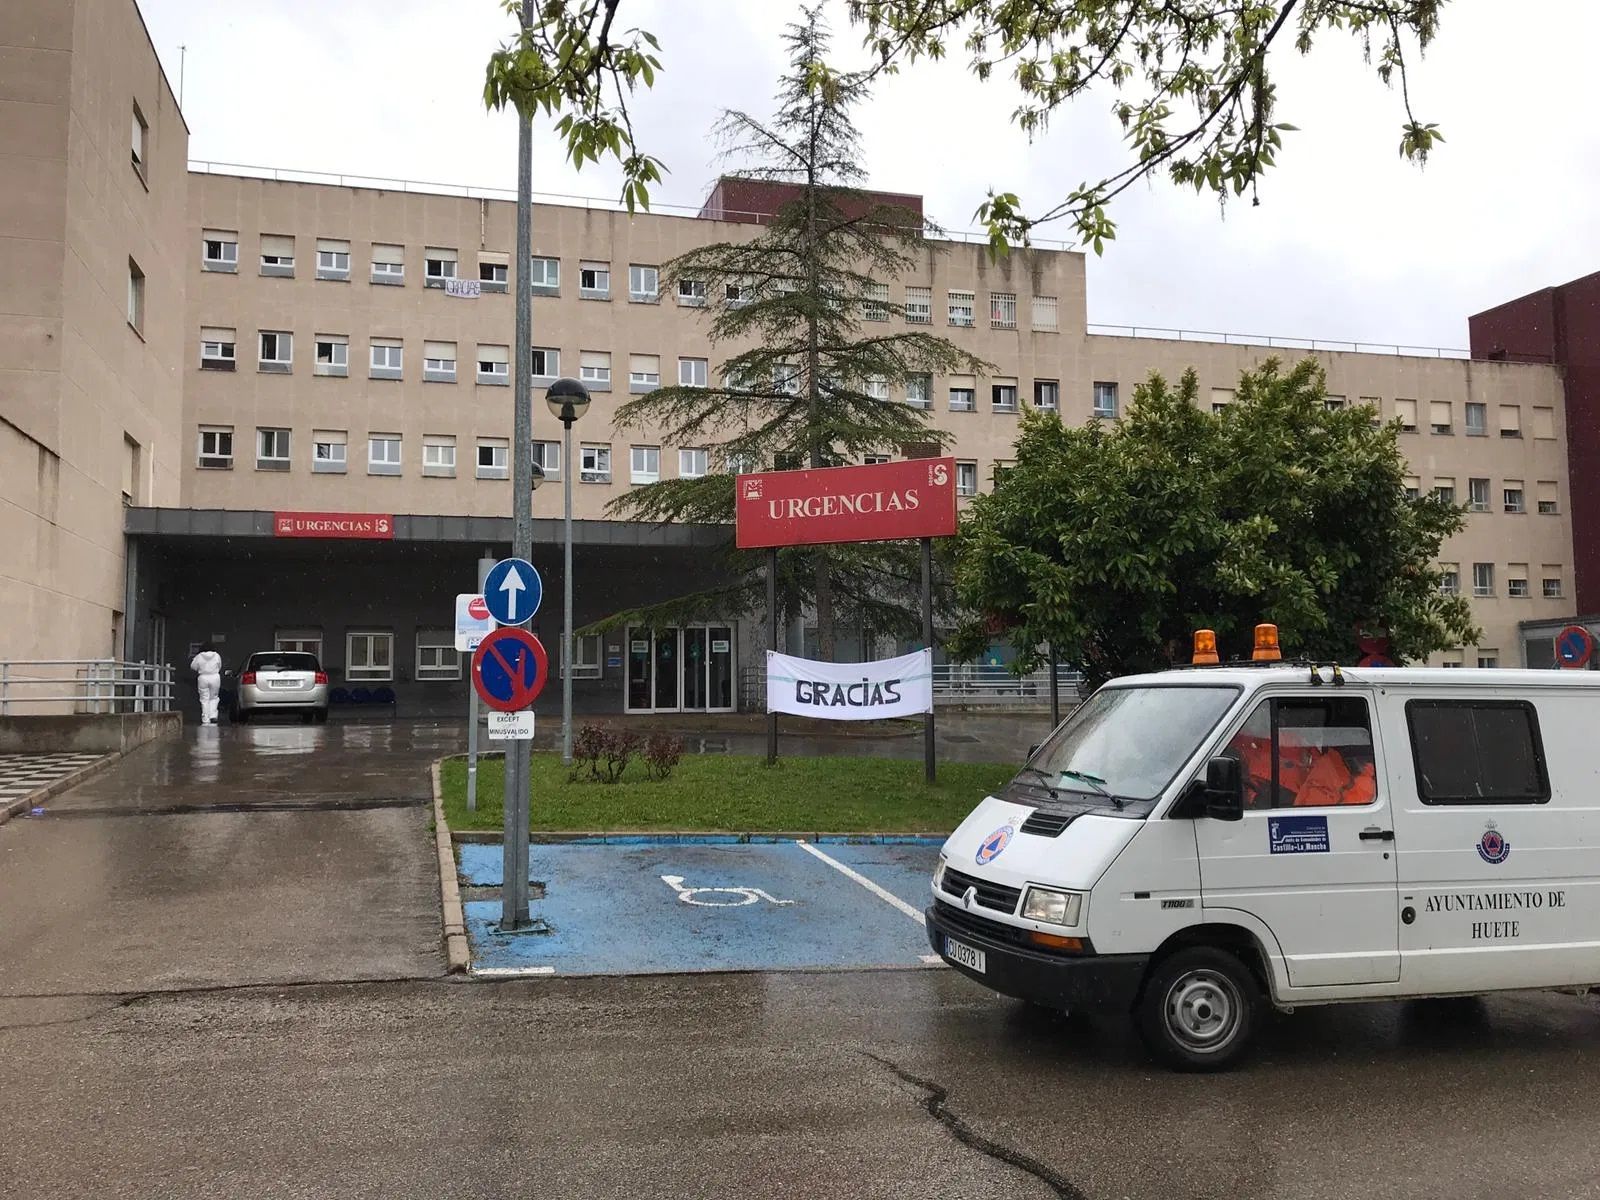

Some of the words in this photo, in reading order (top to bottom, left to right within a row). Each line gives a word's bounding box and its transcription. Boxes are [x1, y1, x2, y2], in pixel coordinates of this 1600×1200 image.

[768, 489, 919, 520] URGENCIAS
[296, 520, 371, 532] URGENCIAS
[1425, 892, 1543, 913] AYUNTAMIENTO
[1548, 891, 1566, 908] DE
[1471, 921, 1520, 939] HUETE
